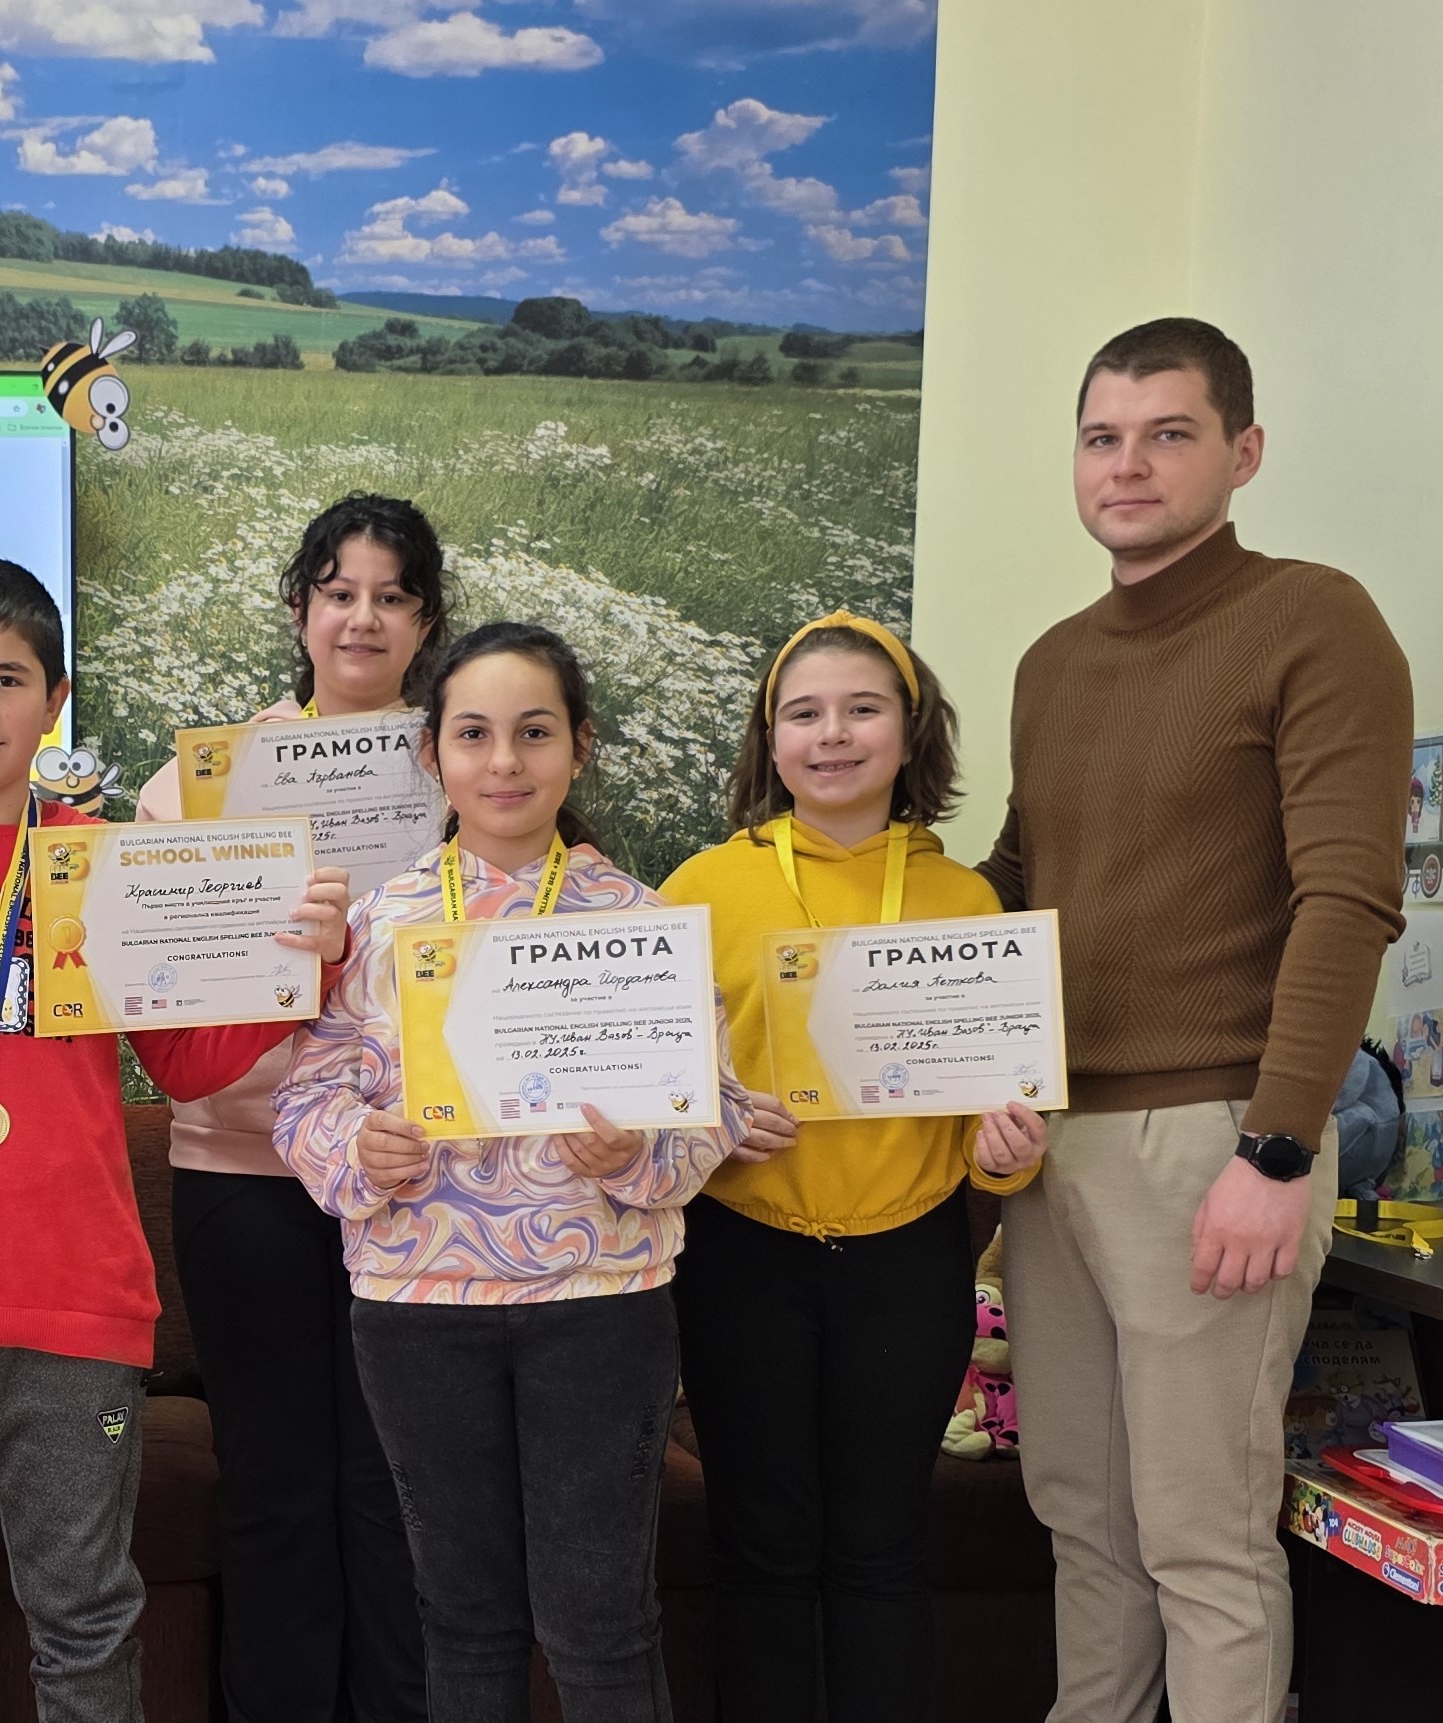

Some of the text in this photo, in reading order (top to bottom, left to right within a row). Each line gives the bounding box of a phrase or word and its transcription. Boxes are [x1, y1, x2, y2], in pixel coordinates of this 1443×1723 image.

[261, 733, 301, 743] BULGARIAN
[304, 730, 338, 738] NATIONAL
[341, 727, 372, 735] ENGLISH
[374, 723, 407, 731] SPELLING
[276, 733, 410, 762] ГРАМОТА
[274, 771, 297, 785] Ева
[120, 837, 164, 846] BULGARIAN
[166, 835, 204, 843] NATIONAL
[207, 833, 239, 841] ENGLISH
[242, 831, 275, 839] SPELLING
[314, 843, 386, 855] ONGRATULATIONS!
[120, 842, 294, 866] SCHOOL WINNER
[125, 875, 262, 903] Красимир Георгиев
[448, 868, 458, 909] BULGARIAN
[538, 870, 557, 915] ELLING BEE
[492, 933, 541, 942] BULGARIAN
[543, 929, 586, 938] NATIONAL
[589, 927, 624, 935] ENGLISH
[627, 924, 668, 933] SPELLING
[851, 937, 897, 947] BULGARIAN
[899, 934, 939, 943] NATIONAL
[942, 931, 976, 940] ENGLISH
[979, 928, 1018, 937] SPELLING
[167, 950, 247, 961] CONGRATULATIONS!
[510, 935, 672, 964] ГРАМОТА
[868, 939, 1022, 967] ГРАМОТА
[503, 965, 676, 1000] Александра Йорданова
[862, 970, 997, 992] Далия Петкова
[549, 1063, 642, 1073] CONGRATULATIONS!
[906, 1054, 994, 1064] CONGRATULATIONS!
